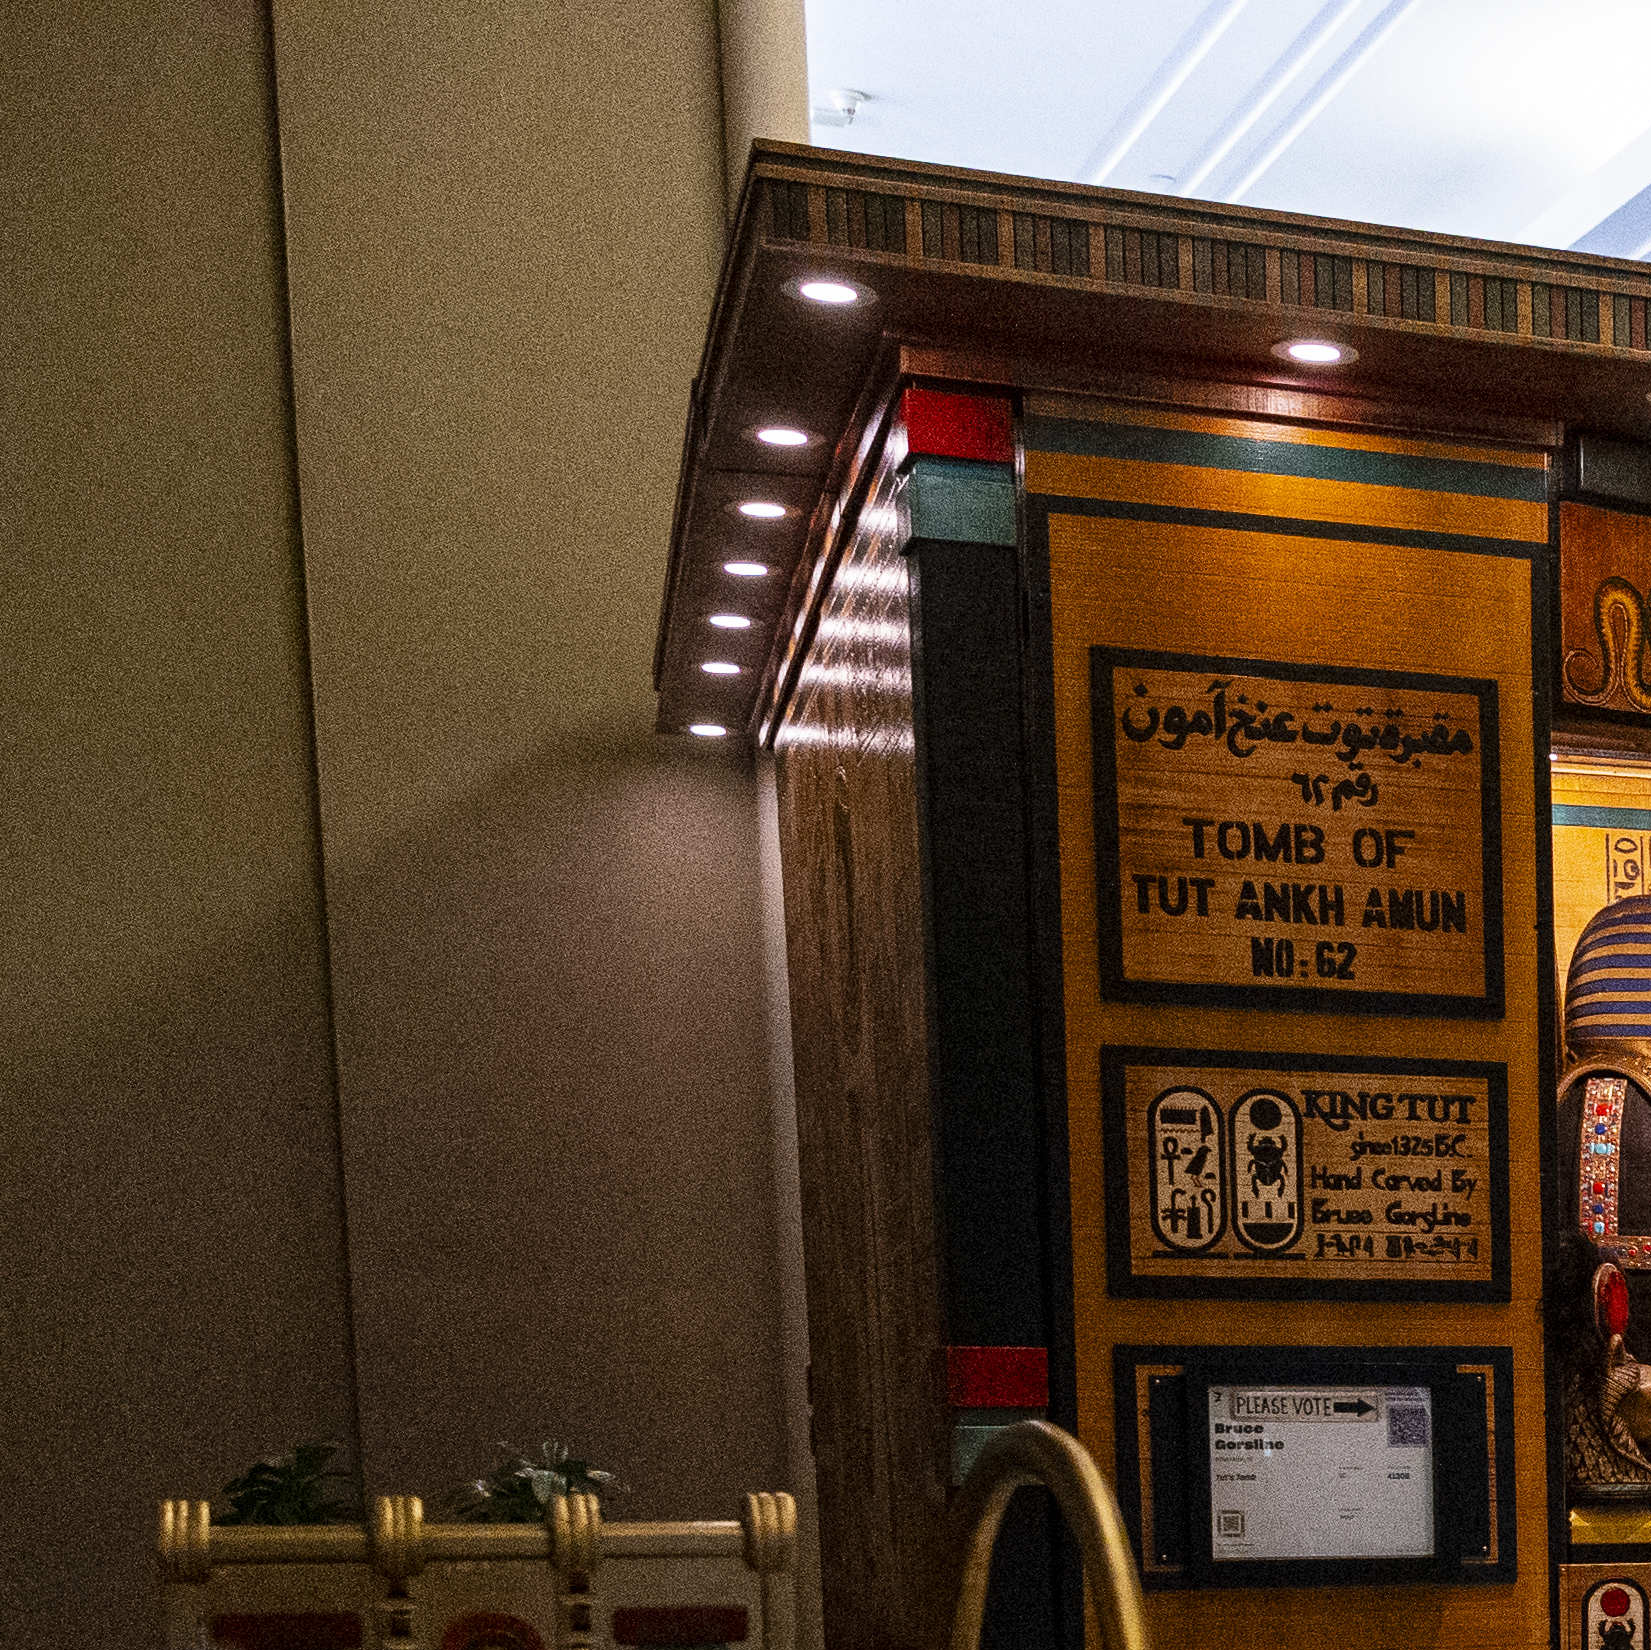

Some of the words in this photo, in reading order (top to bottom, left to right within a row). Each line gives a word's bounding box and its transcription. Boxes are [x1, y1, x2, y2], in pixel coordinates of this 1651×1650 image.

[1227, 694, 1298, 757] عنخ
[1182, 817, 1325, 865] TOMB
[1352, 827, 1414, 869] OF
[1131, 873, 1215, 917] TUT
[1236, 881, 1344, 926] ANKH
[1361, 887, 1466, 933] AMUN
[1301, 1090, 1394, 1131] KING
[1398, 1094, 1476, 1124] TUT
[1311, 1165, 1362, 1190] Hand
[1372, 1168, 1442, 1192] Carved
[1451, 1169, 1478, 1201] By
[1312, 1198, 1373, 1224] Bruce
[1236, 1396, 1288, 1415] PLEASE
[1293, 1397, 1331, 1416] VOTE
[1215, 1423, 1264, 1434] Bruce
[1215, 1439, 1284, 1450] Gorsline
